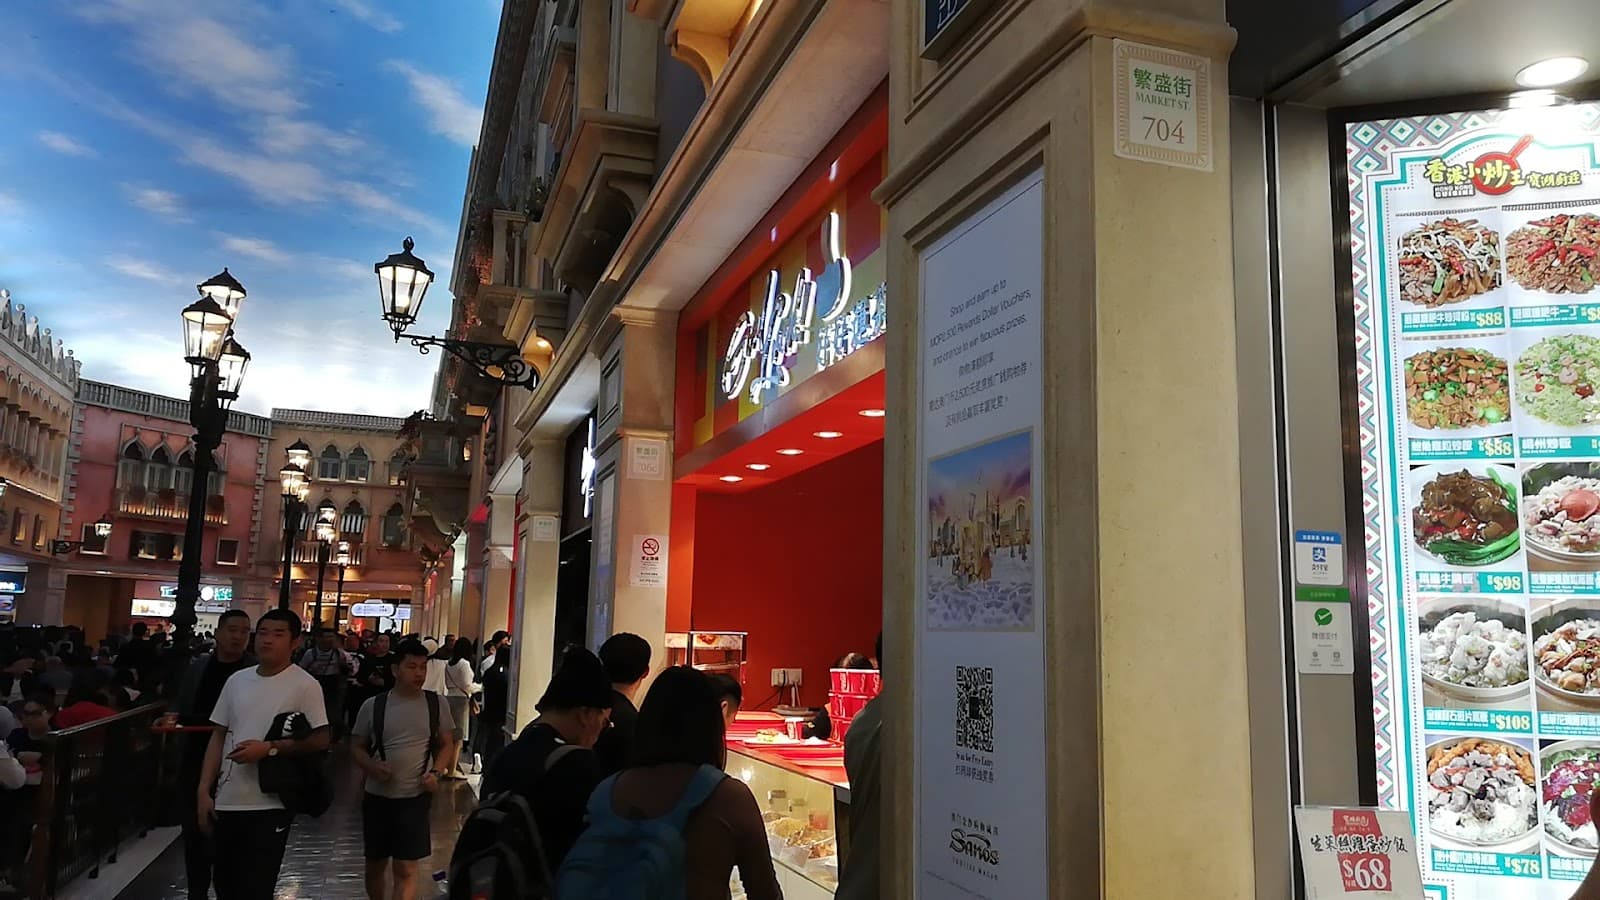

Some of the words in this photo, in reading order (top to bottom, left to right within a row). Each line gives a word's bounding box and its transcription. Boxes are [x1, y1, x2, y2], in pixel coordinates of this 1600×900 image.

[1134, 68, 1192, 98] 繁盛街
[1135, 92, 1176, 107] MARKET
[1178, 99, 1192, 111] ST.
[1142, 116, 1185, 144] 704
[1424, 158, 1525, 188] 香港小炒王
[1476, 311, 1503, 327] $88
[1484, 440, 1512, 457] $88
[1494, 575, 1521, 591] $98
[1495, 714, 1530, 730] $108
[949, 828, 1000, 866] Sands
[1342, 858, 1387, 889] $68
[1511, 857, 1540, 875] $78
